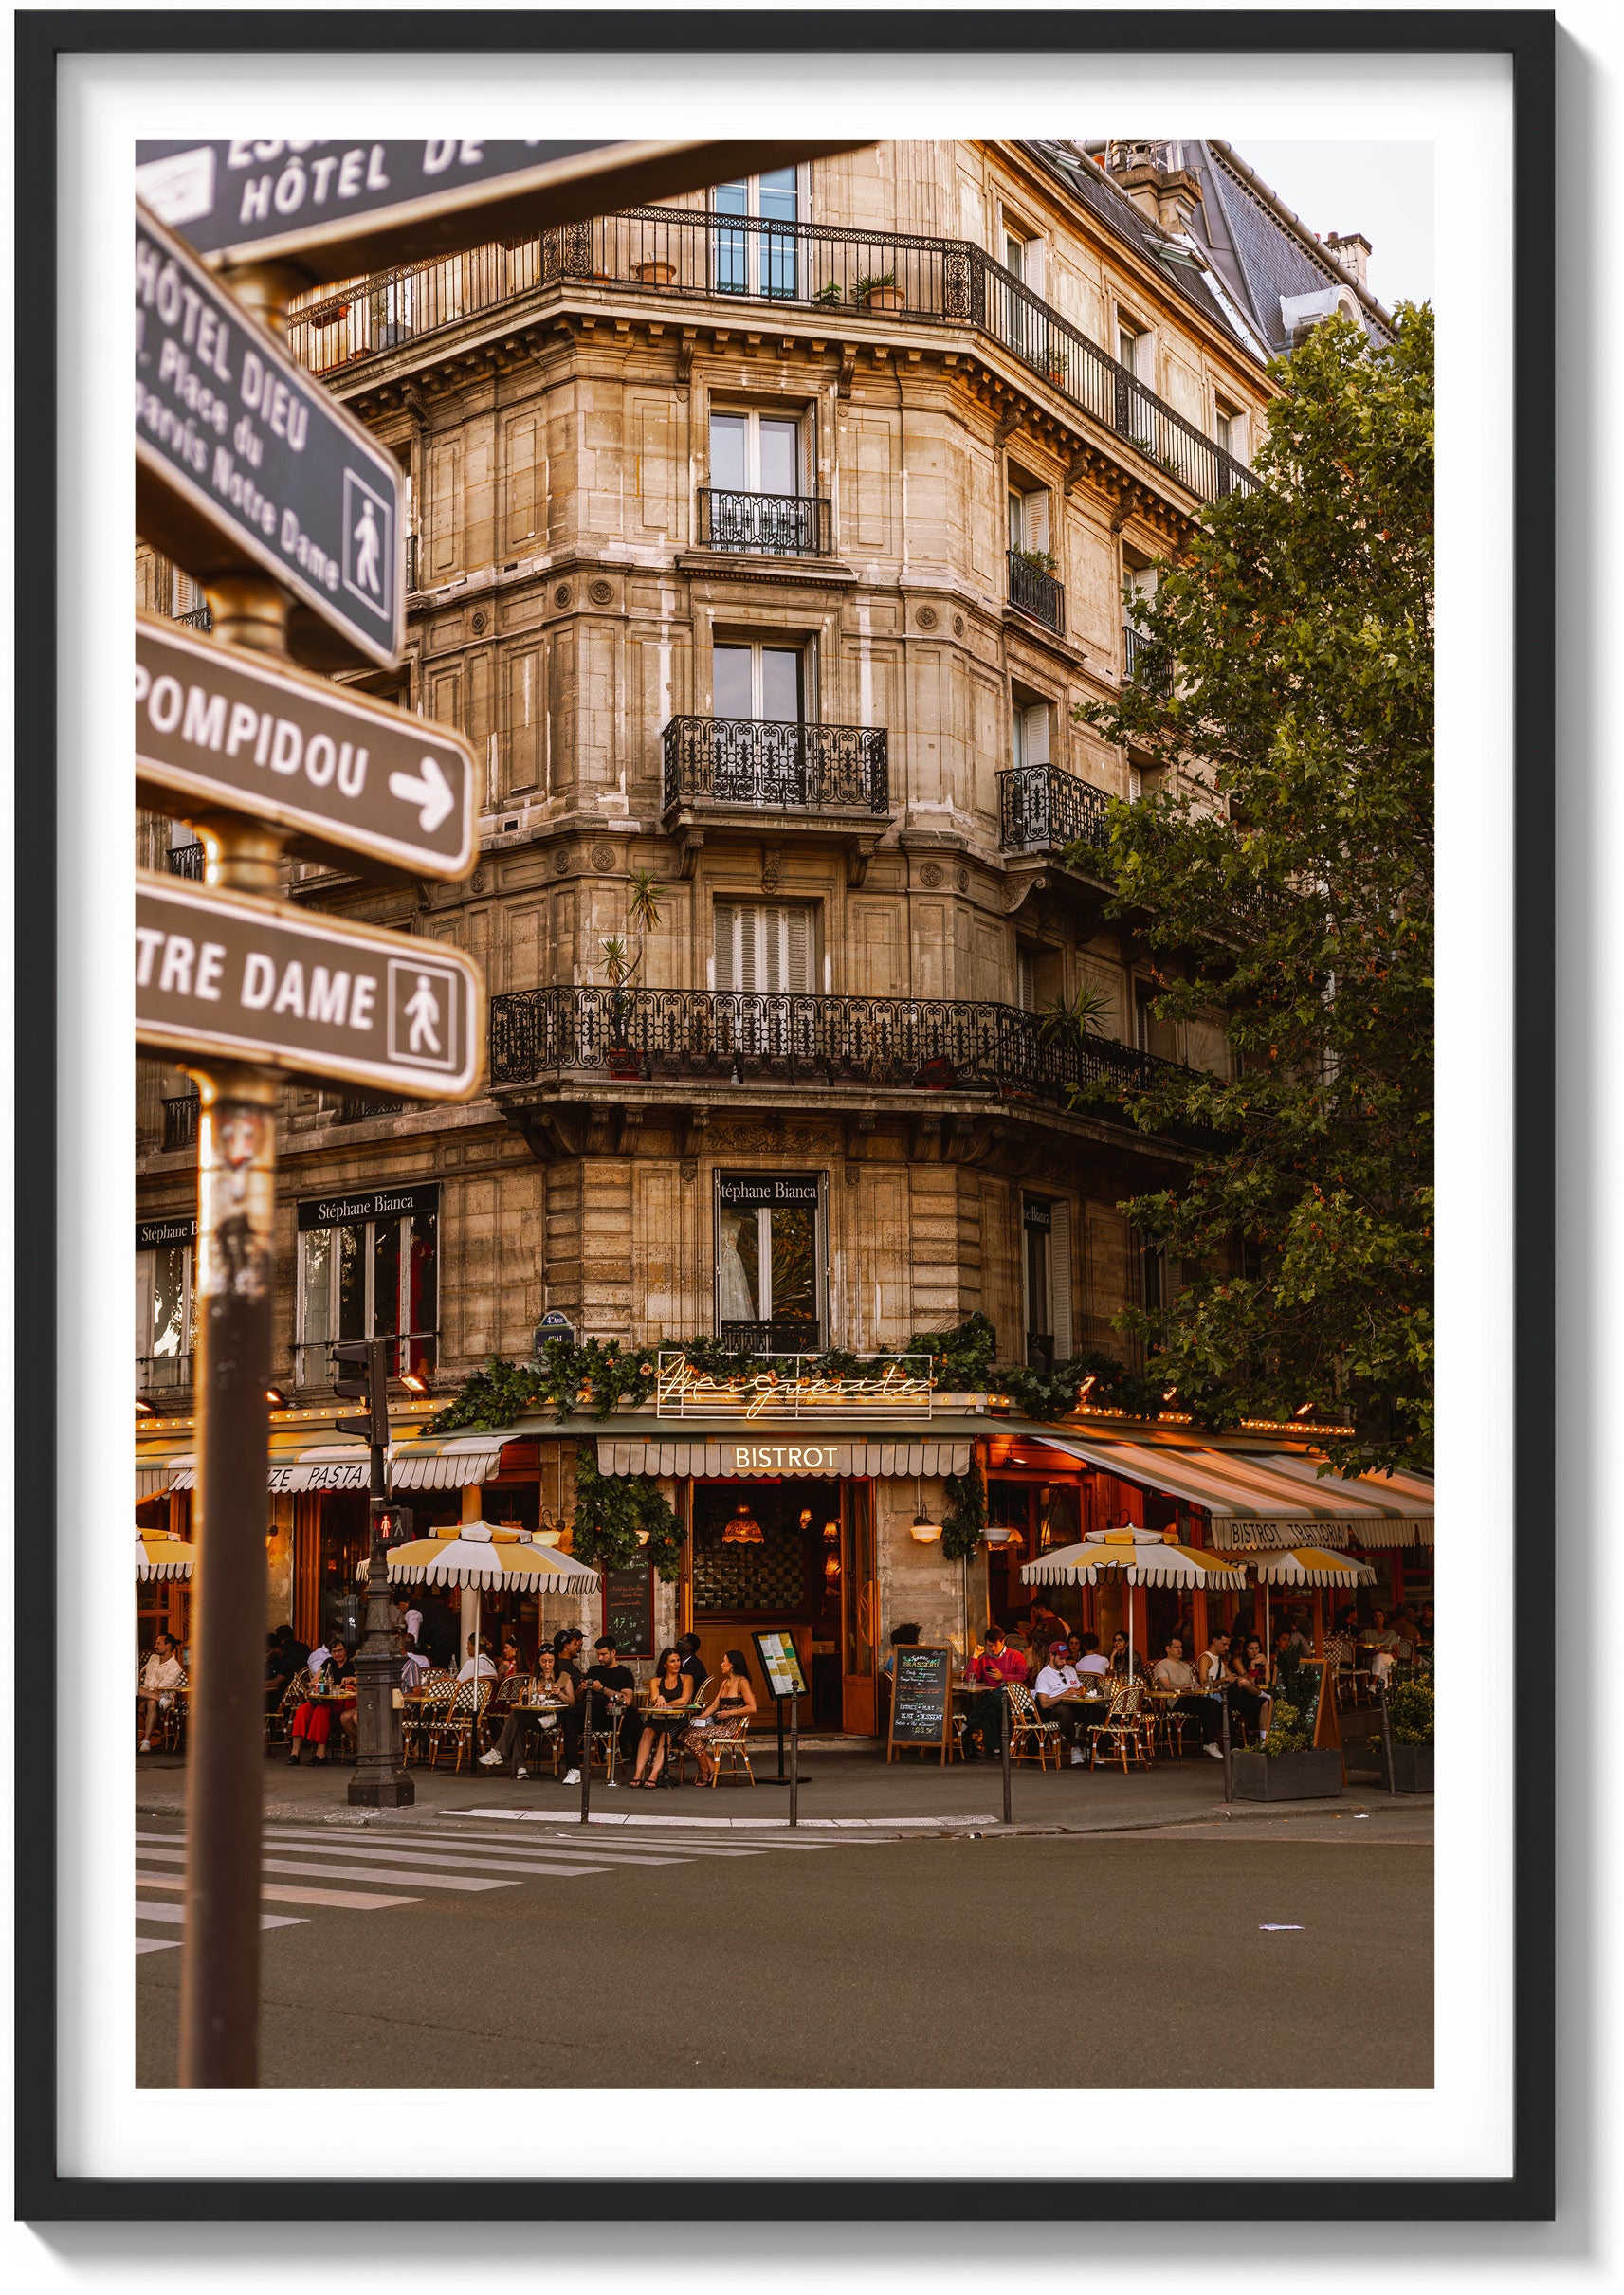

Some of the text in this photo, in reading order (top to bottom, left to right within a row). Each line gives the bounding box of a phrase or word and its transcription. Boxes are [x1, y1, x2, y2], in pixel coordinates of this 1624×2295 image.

[239, 144, 390, 224] HÔTEL
[136, 238, 309, 453] HÔTEL DIEU
[159, 337, 229, 436] Place
[233, 415, 263, 468] du
[212, 446, 277, 536] Notre
[281, 507, 340, 592] Dame
[240, 952, 377, 1031] DAME
[319, 1194, 414, 1222] Stéphane Bianca
[719, 1181, 817, 1202] téphane Bianca
[141, 1224, 188, 1244] Stéphane
[661, 1355, 932, 1419] Marguerite
[307, 1466, 363, 1485] PASTA
[736, 1447, 838, 1468] BISTROT
[1232, 1523, 1344, 1544] BISTROT TRATTORIA
